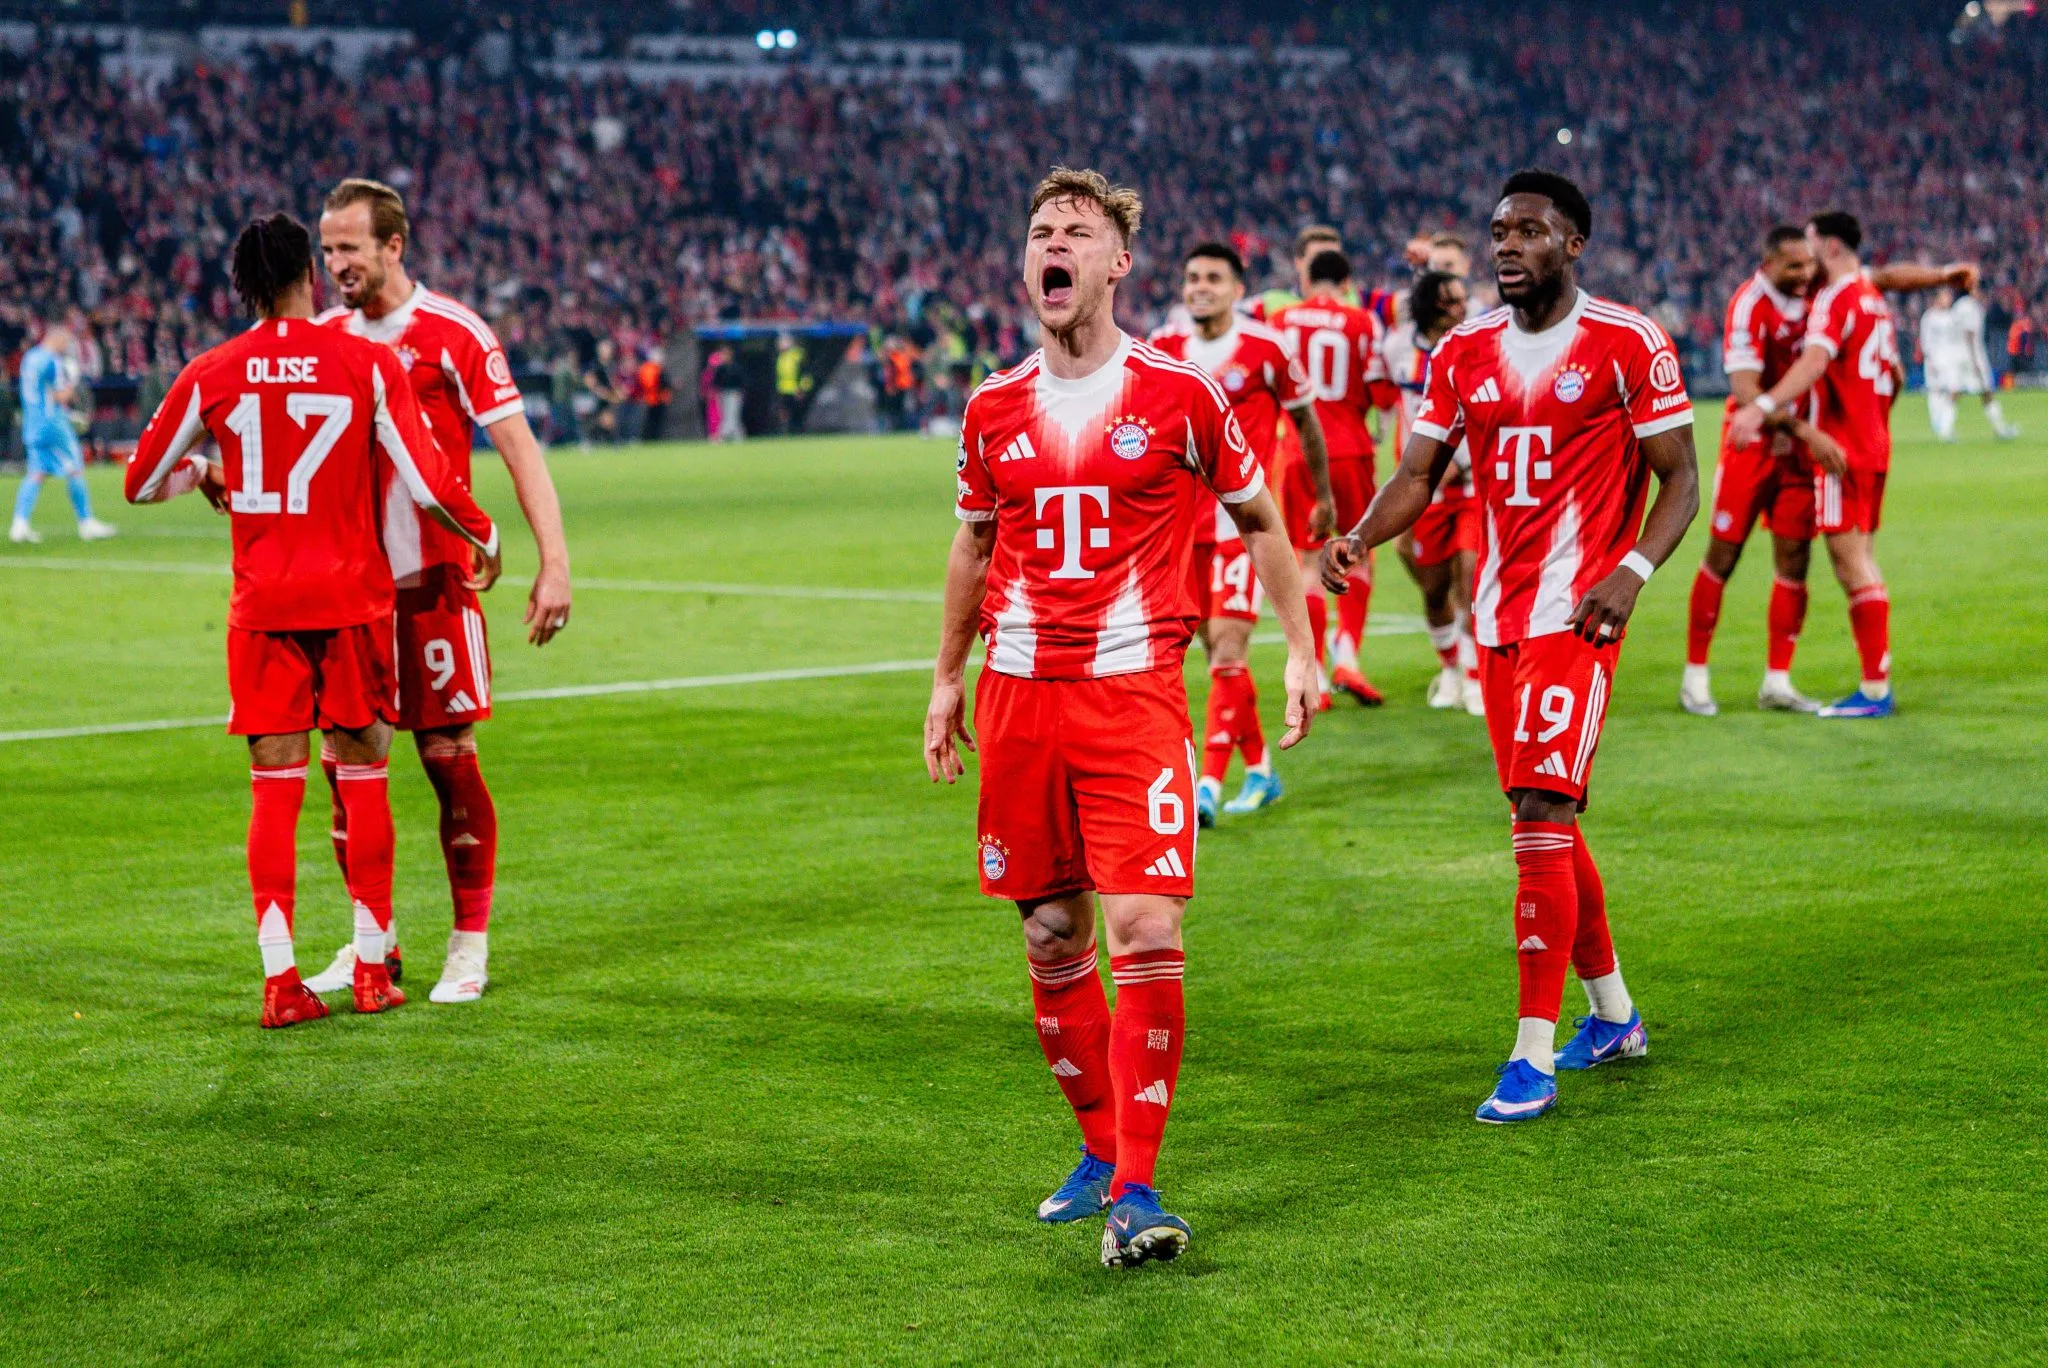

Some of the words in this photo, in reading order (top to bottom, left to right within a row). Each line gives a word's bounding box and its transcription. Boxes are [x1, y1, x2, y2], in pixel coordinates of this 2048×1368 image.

[246, 356, 319, 384] OLISE
[1652, 390, 1689, 413] Allian
[1122, 426, 1146, 440] BAYERN
[224, 393, 353, 515] 17
[1211, 552, 1250, 592] 14
[424, 638, 456, 691] 9
[1514, 683, 1576, 743] 19
[1147, 768, 1185, 835] 6
[1040, 1017, 1058, 1025] MIA
[1147, 1041, 1168, 1051] MIA
[1148, 1034, 1168, 1043] SAN
